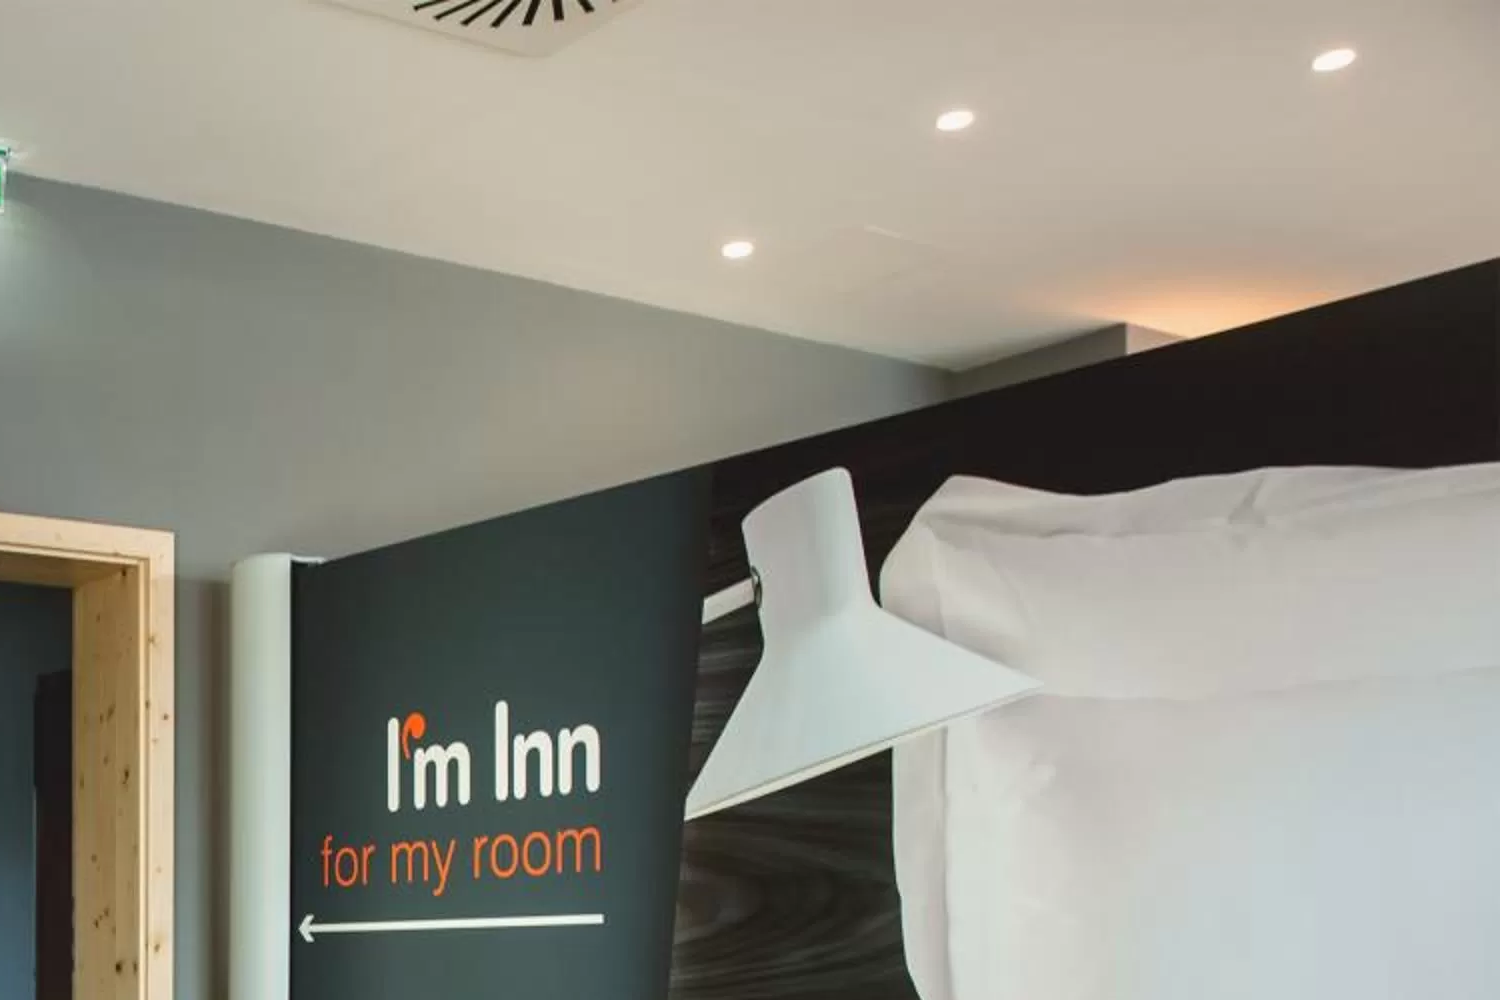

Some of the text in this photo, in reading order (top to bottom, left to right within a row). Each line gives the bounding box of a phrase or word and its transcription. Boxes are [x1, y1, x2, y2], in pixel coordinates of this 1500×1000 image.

[387, 700, 600, 813] I'm Inn
[320, 824, 601, 897] for my room
